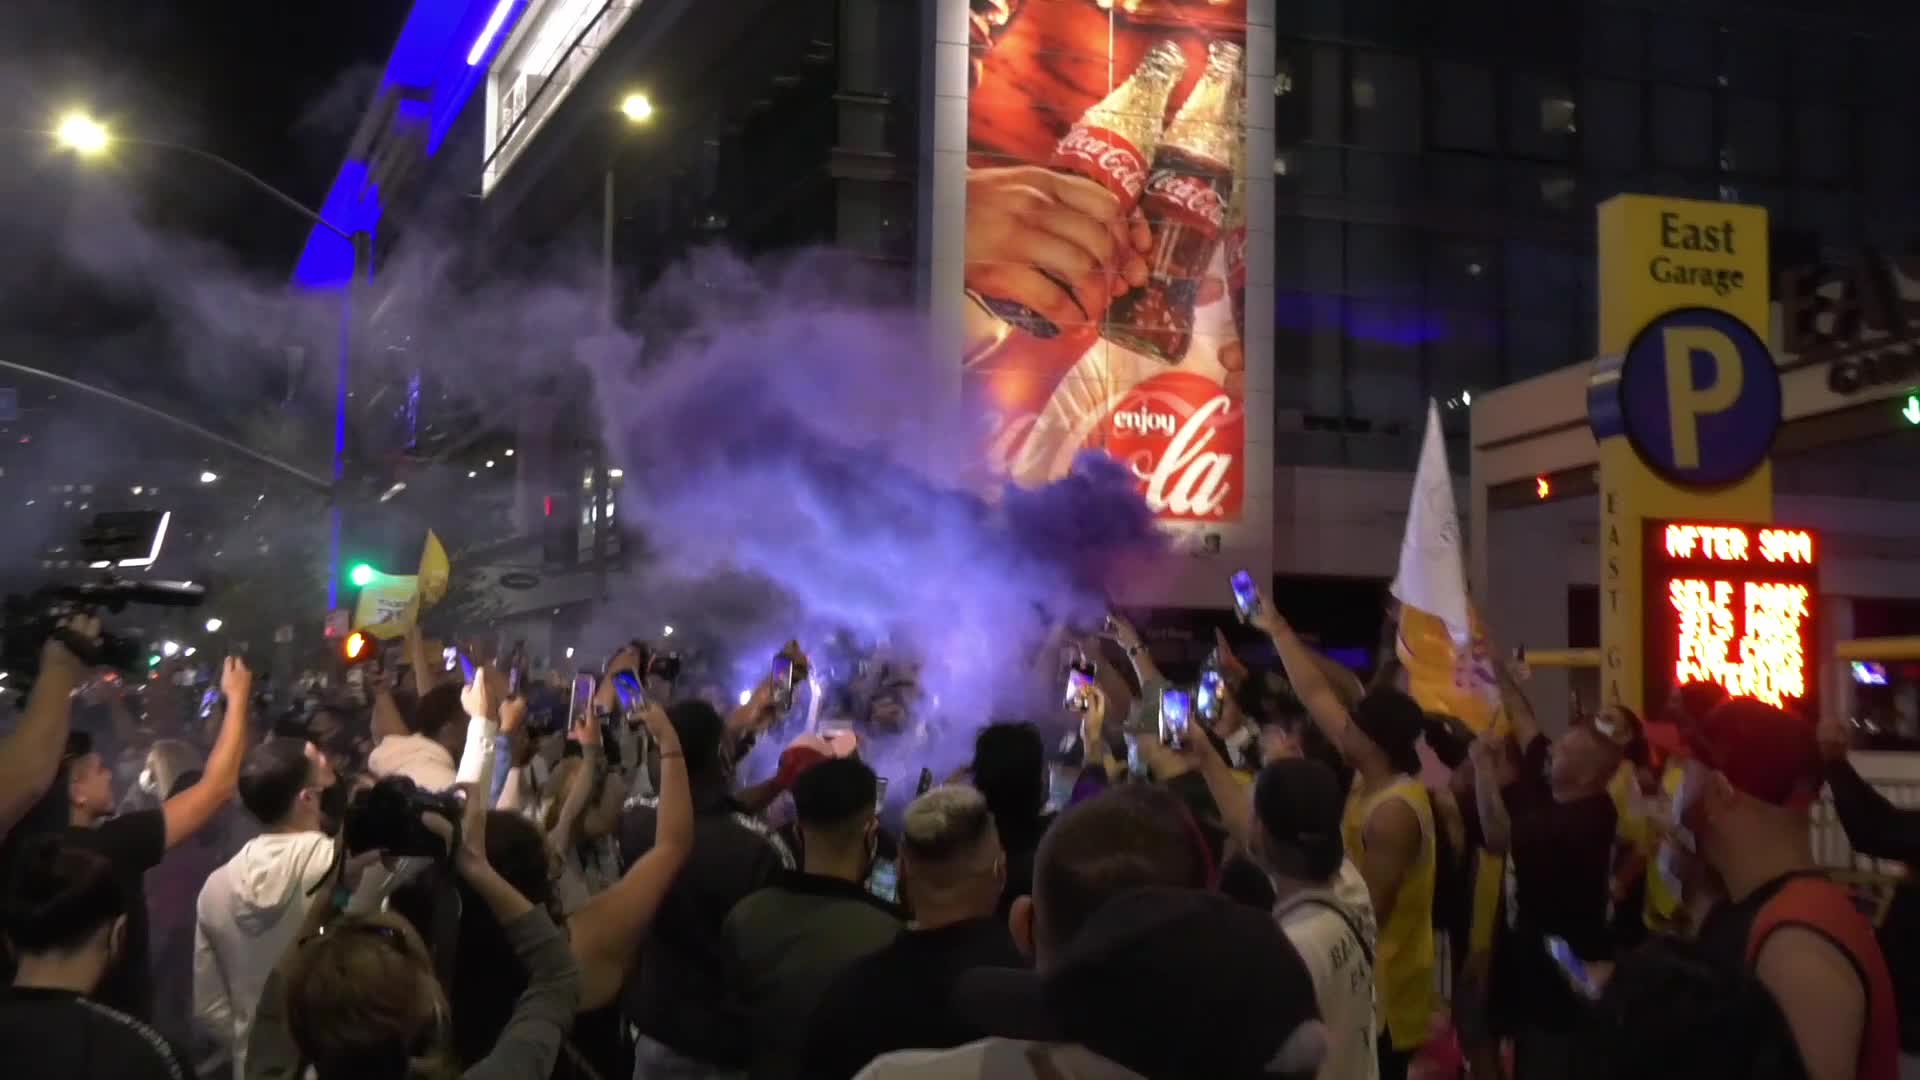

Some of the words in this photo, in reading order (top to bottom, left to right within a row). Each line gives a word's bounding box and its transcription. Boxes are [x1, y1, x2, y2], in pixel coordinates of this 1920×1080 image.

[1661, 211, 1736, 255] East
[1649, 257, 1744, 296] Garage
[1663, 326, 1745, 470] P
[1113, 404, 1176, 437] enjoy
[1607, 491, 1621, 612] EAST
[1665, 524, 1750, 561] AFTER
